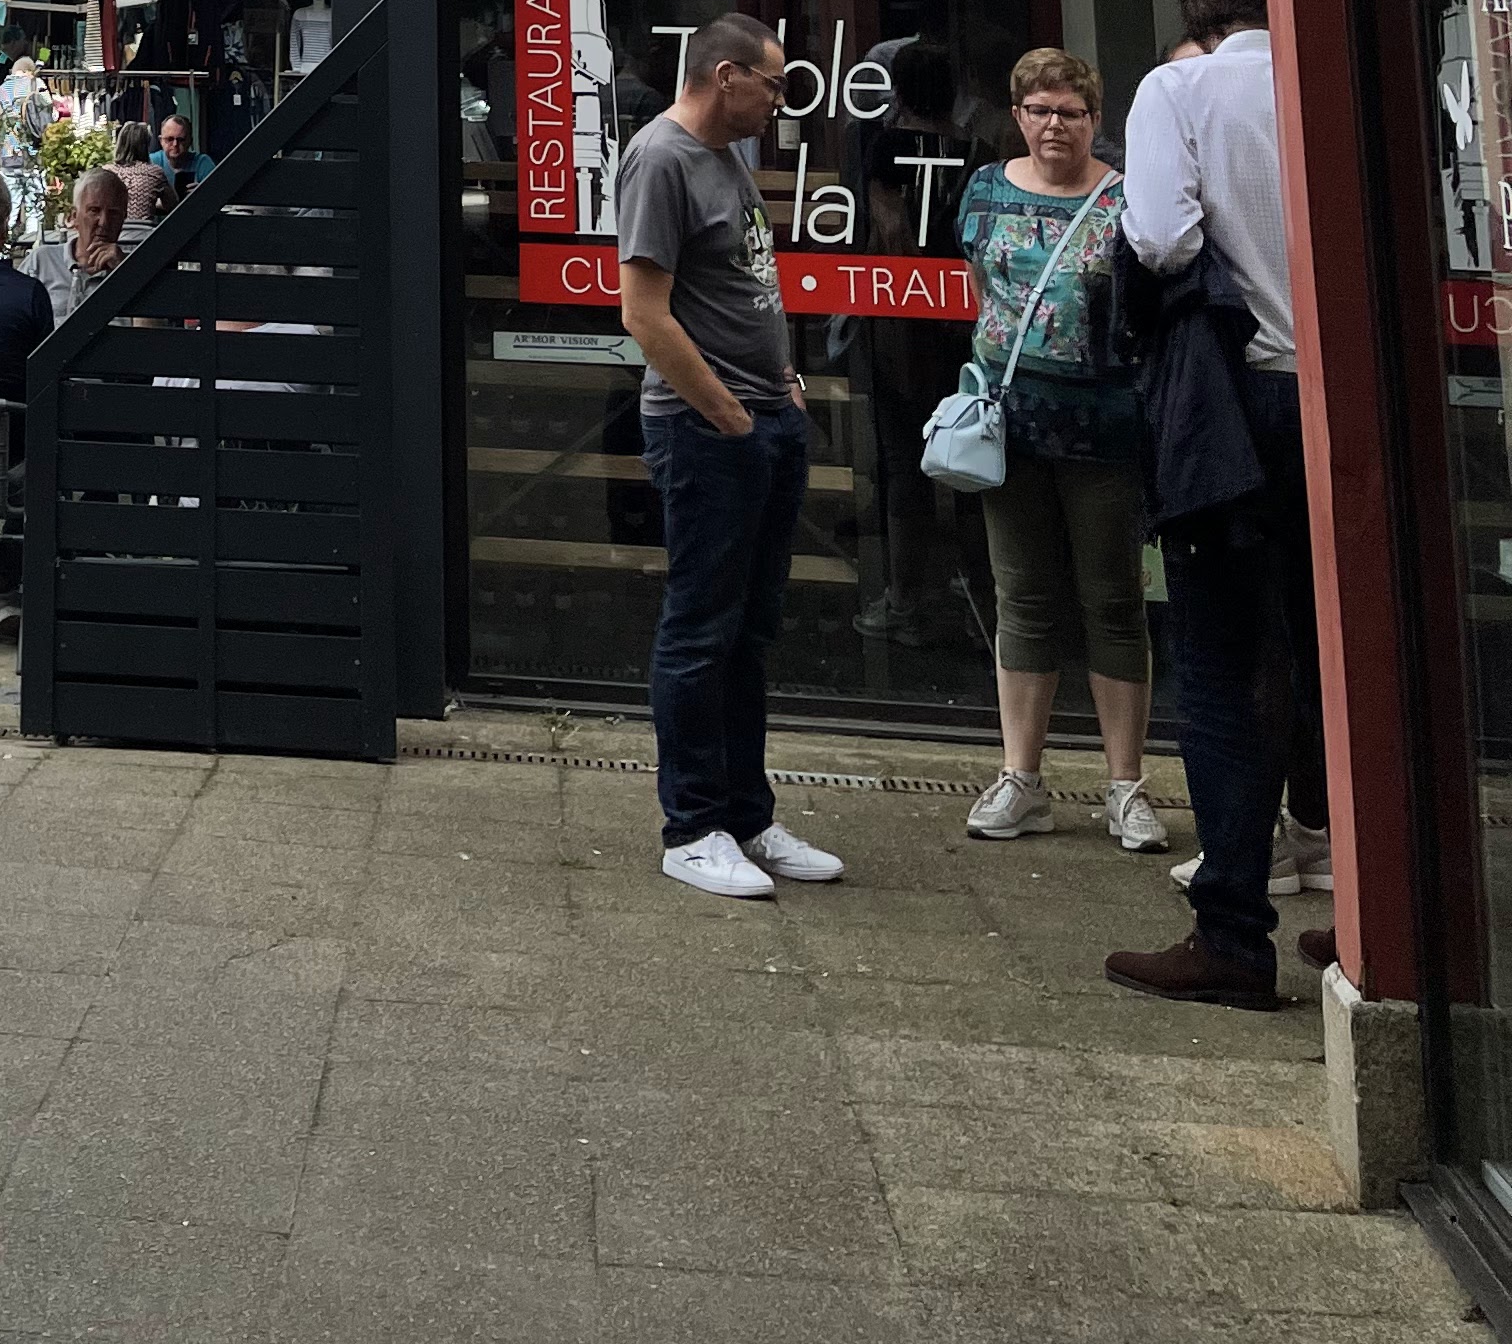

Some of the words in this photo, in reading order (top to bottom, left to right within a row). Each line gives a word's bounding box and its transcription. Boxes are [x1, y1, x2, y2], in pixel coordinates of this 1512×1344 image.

[651, 18, 892, 119] Tble
[791, 142, 856, 245] la
[559, 335, 599, 346] VISION
